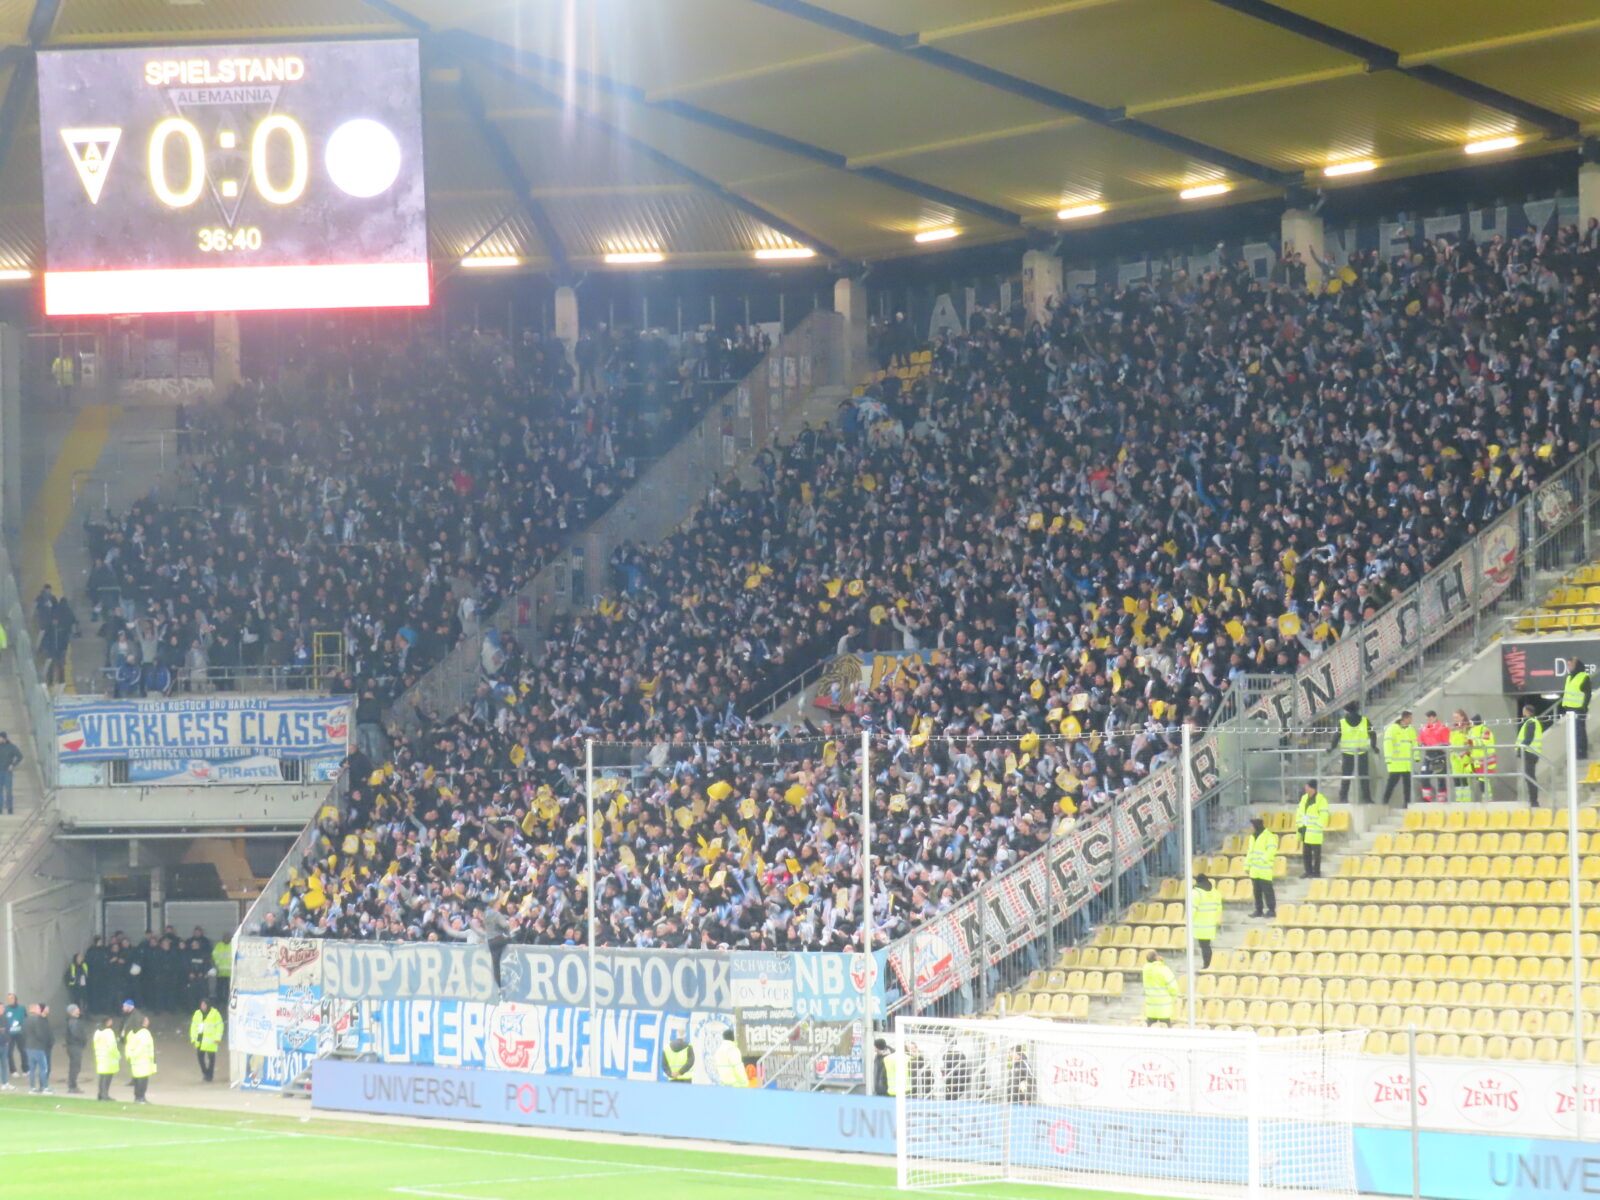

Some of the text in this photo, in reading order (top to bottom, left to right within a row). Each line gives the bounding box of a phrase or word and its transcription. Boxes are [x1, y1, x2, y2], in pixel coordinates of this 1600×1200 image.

[145, 57, 304, 86] SPIELSTAND
[177, 88, 273, 103] ALEMANNIA
[198, 228, 262, 251] 36:40
[80, 711, 327, 747] WORKLESS CLASS
[218, 765, 279, 778] PIRATEN
[322, 948, 495, 1000] SUPTRAS
[525, 952, 731, 1008] ROSTOCK
[794, 953, 845, 995] NB
[796, 998, 822, 1017] ON
[1053, 1064, 1099, 1088] ZENTIS
[1128, 1069, 1176, 1092] ZENTIS
[363, 1073, 620, 1119] UNIVERSAL POLYTHEX
[1374, 1080, 1428, 1106] ZENTS
[1463, 1086, 1519, 1112] ZENTIS
